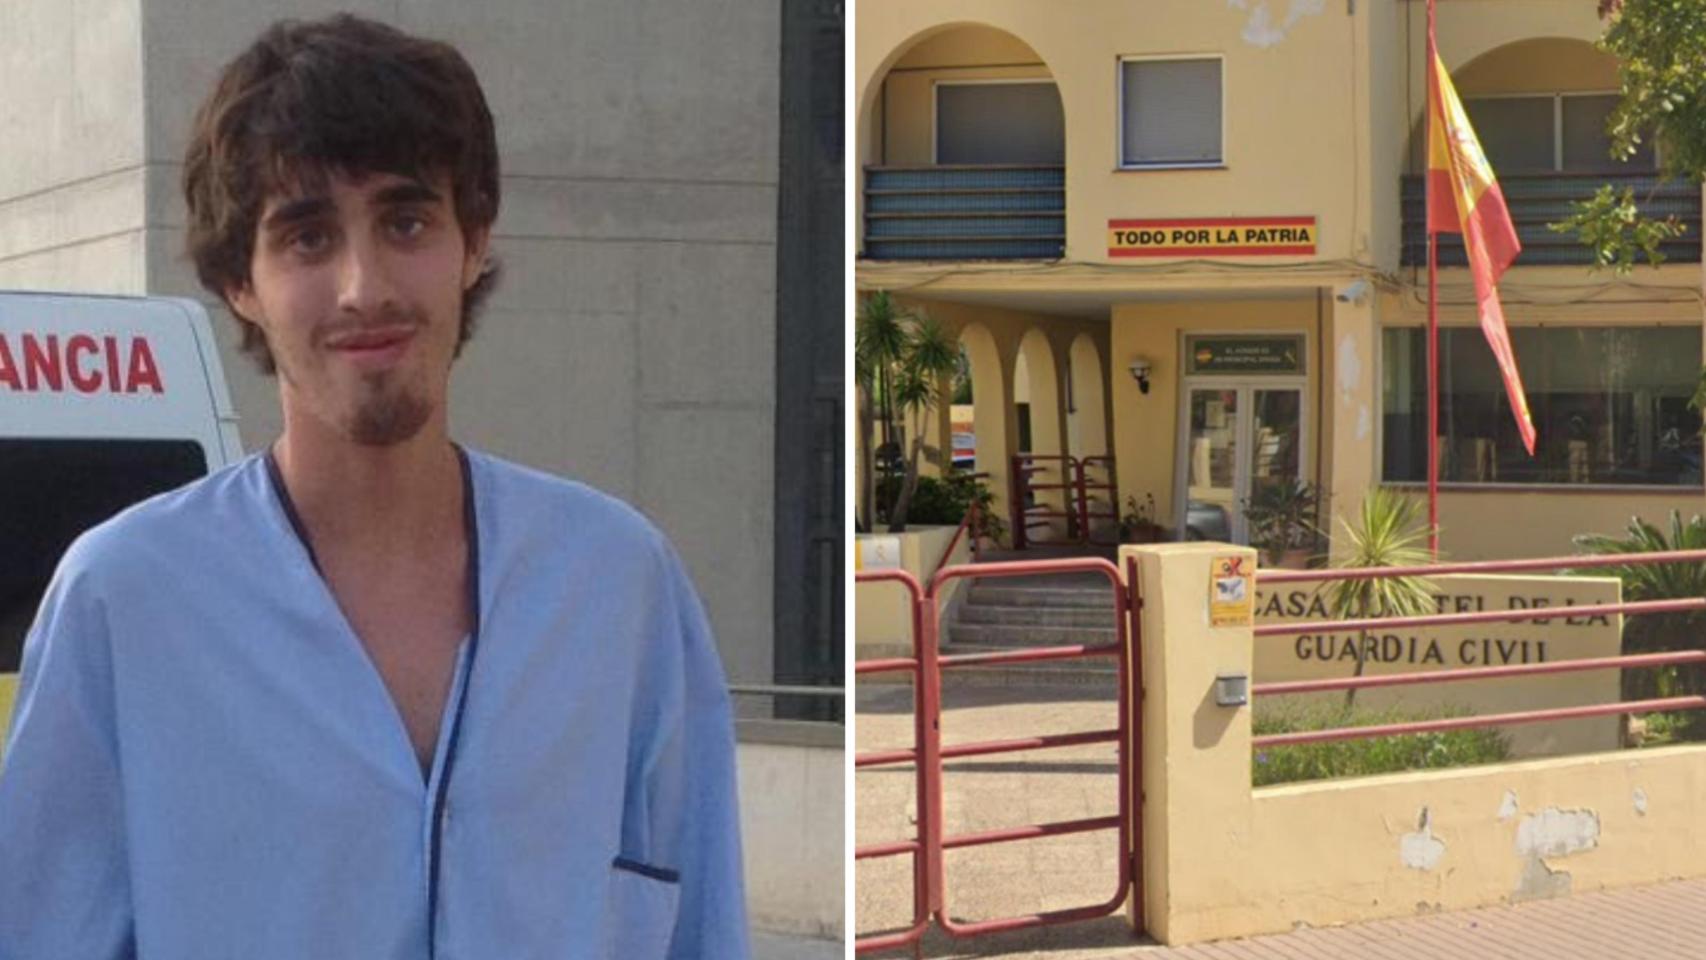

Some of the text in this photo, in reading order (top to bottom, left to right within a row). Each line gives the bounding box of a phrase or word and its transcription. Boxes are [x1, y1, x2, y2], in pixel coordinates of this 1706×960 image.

[1114, 228, 1310, 245] TODO POR LA PATRIA
[1295, 634, 1445, 665] GUARDIA
